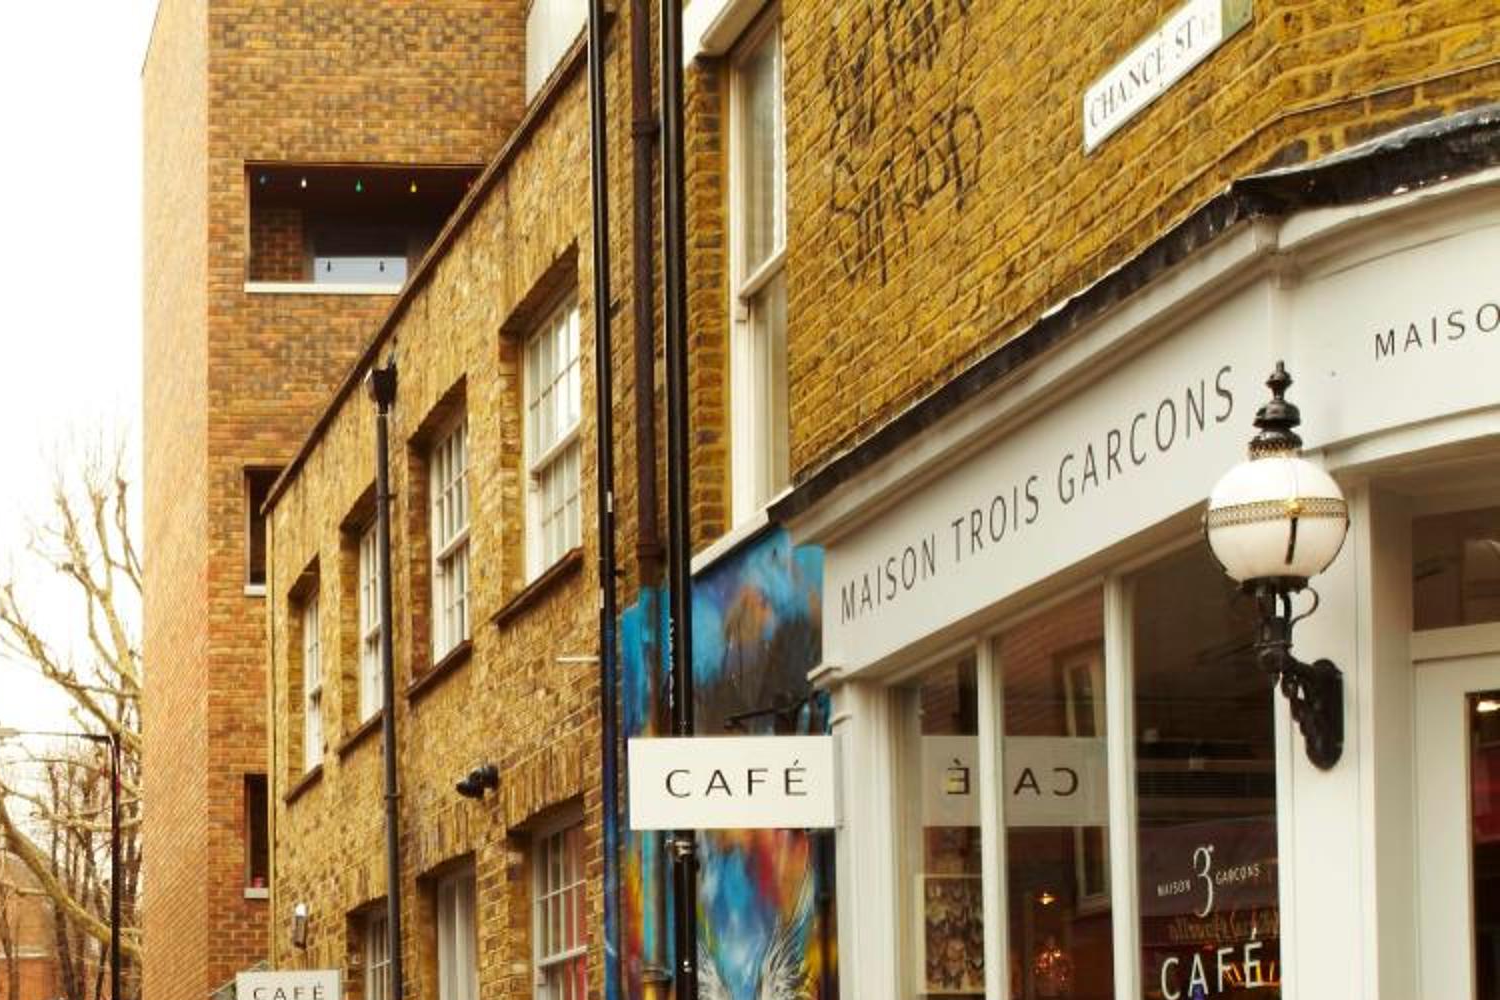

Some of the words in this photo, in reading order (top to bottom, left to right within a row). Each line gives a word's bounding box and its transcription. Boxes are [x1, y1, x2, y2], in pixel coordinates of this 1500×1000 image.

[1089, 44, 1165, 128] CHANCE
[1174, 15, 1198, 50] ST
[840, 532, 936, 626] MAISON
[951, 474, 1040, 563] TROIS
[1057, 364, 1235, 505] GARCONS
[665, 759, 808, 798] CAFÉ
[1193, 845, 1214, 918] 3
